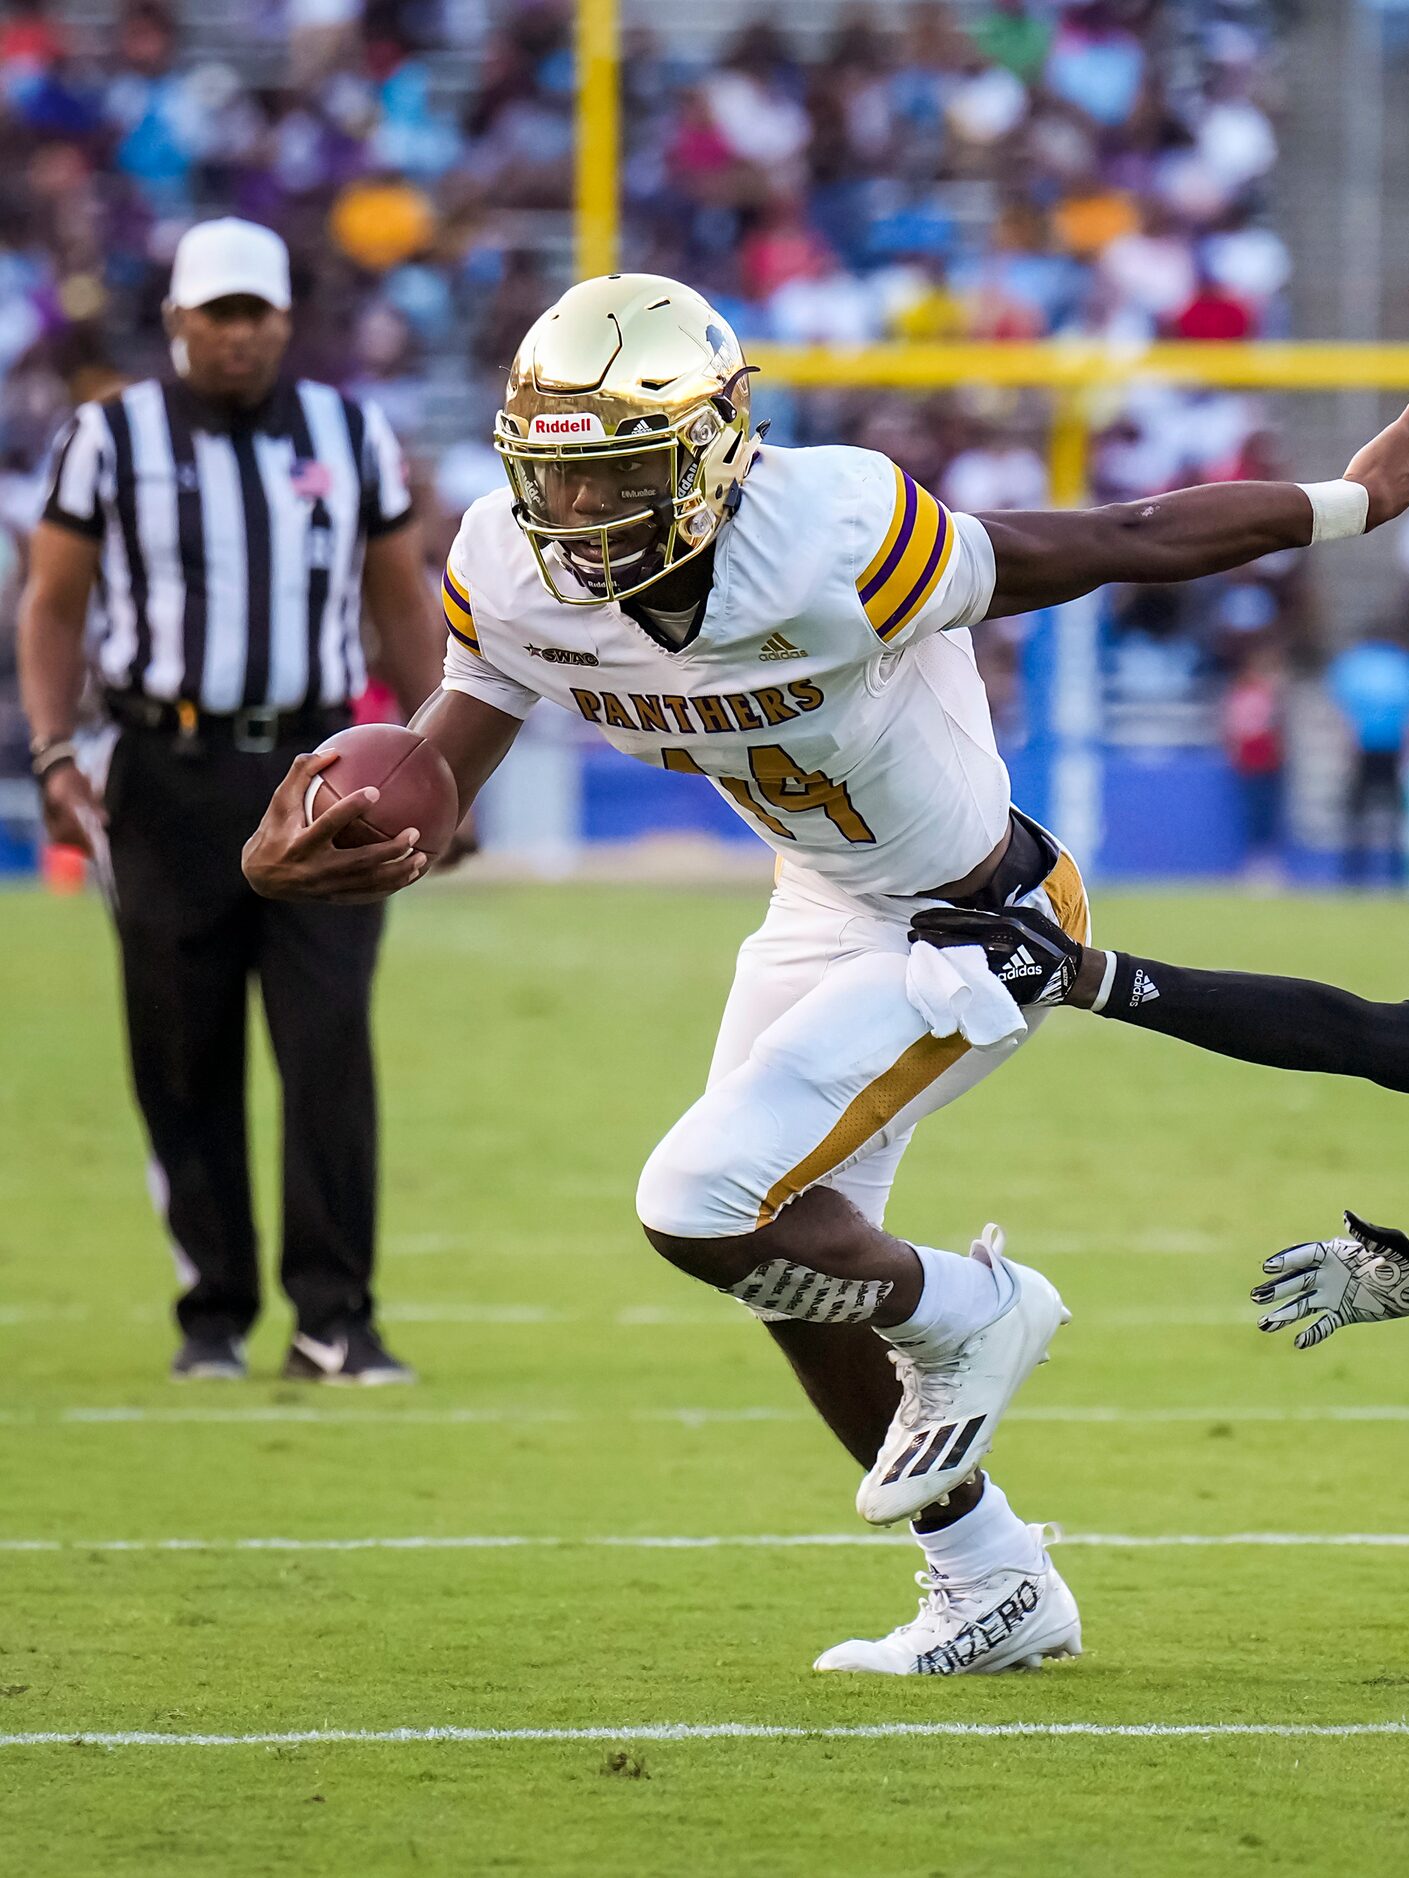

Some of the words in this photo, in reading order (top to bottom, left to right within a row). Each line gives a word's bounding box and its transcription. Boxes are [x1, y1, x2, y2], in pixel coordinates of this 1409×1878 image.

[535, 418, 591, 434] Riddell
[758, 649, 808, 662] adidas
[569, 678, 825, 734] PANTHERS
[660, 743, 877, 844] 14
[997, 963, 1043, 982] adidas
[1129, 968, 1144, 1007] adidas
